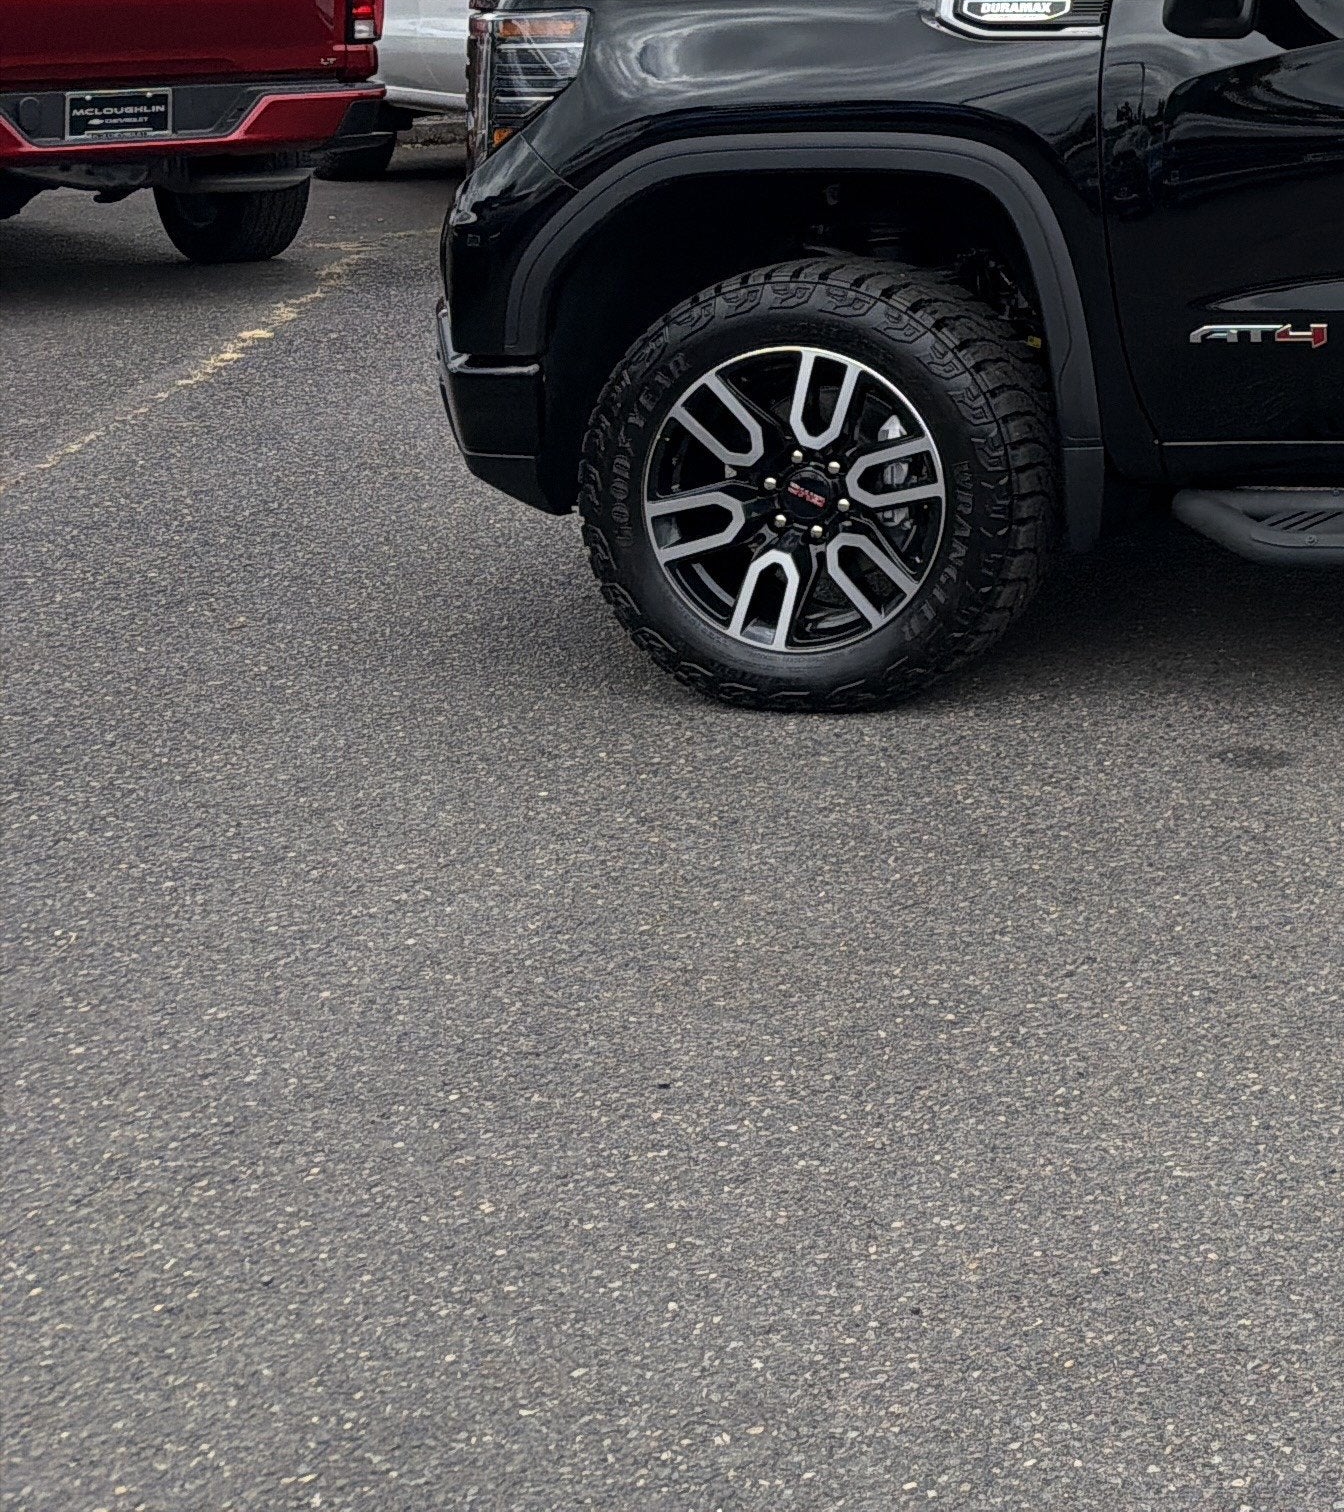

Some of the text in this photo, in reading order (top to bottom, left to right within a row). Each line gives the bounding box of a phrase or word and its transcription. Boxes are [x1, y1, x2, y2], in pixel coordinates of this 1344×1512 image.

[980, 2, 1053, 14] DURAMAX
[71, 104, 166, 117] MCLOUGHLIN
[1189, 323, 1328, 349] AT4
